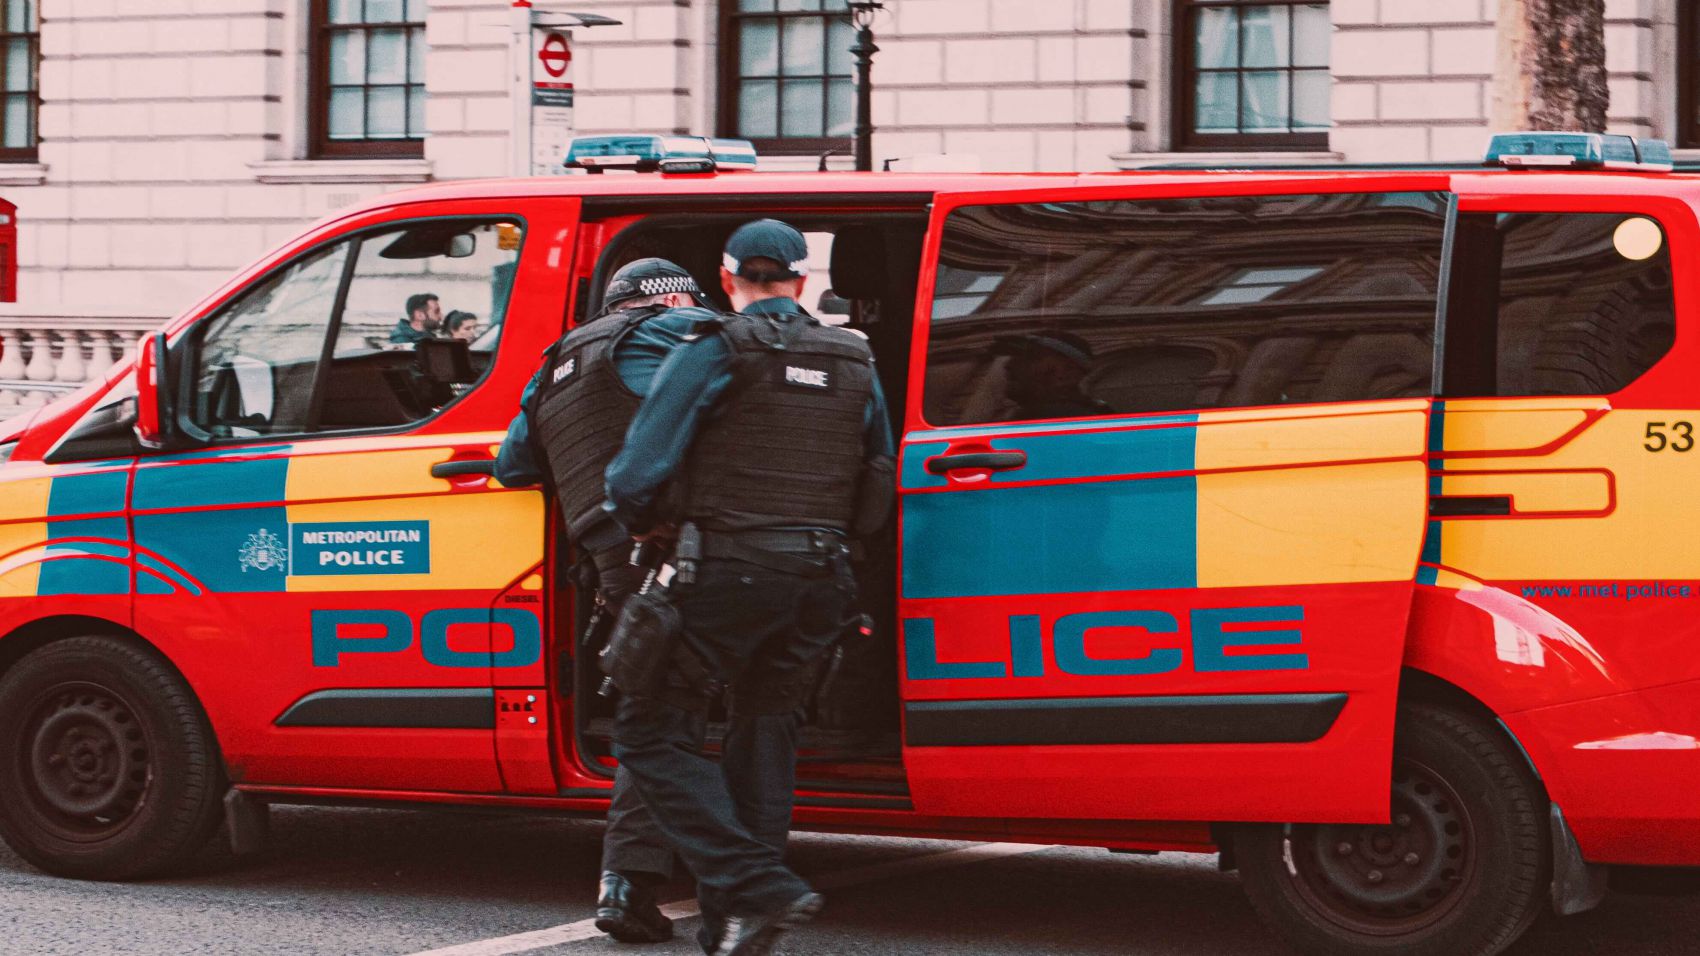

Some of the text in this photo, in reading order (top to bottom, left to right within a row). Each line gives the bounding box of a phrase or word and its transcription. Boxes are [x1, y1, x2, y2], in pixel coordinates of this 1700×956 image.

[1643, 421, 1694, 452] 53
[302, 530, 421, 544] METROPOLITAN
[319, 550, 404, 566] POLICE
